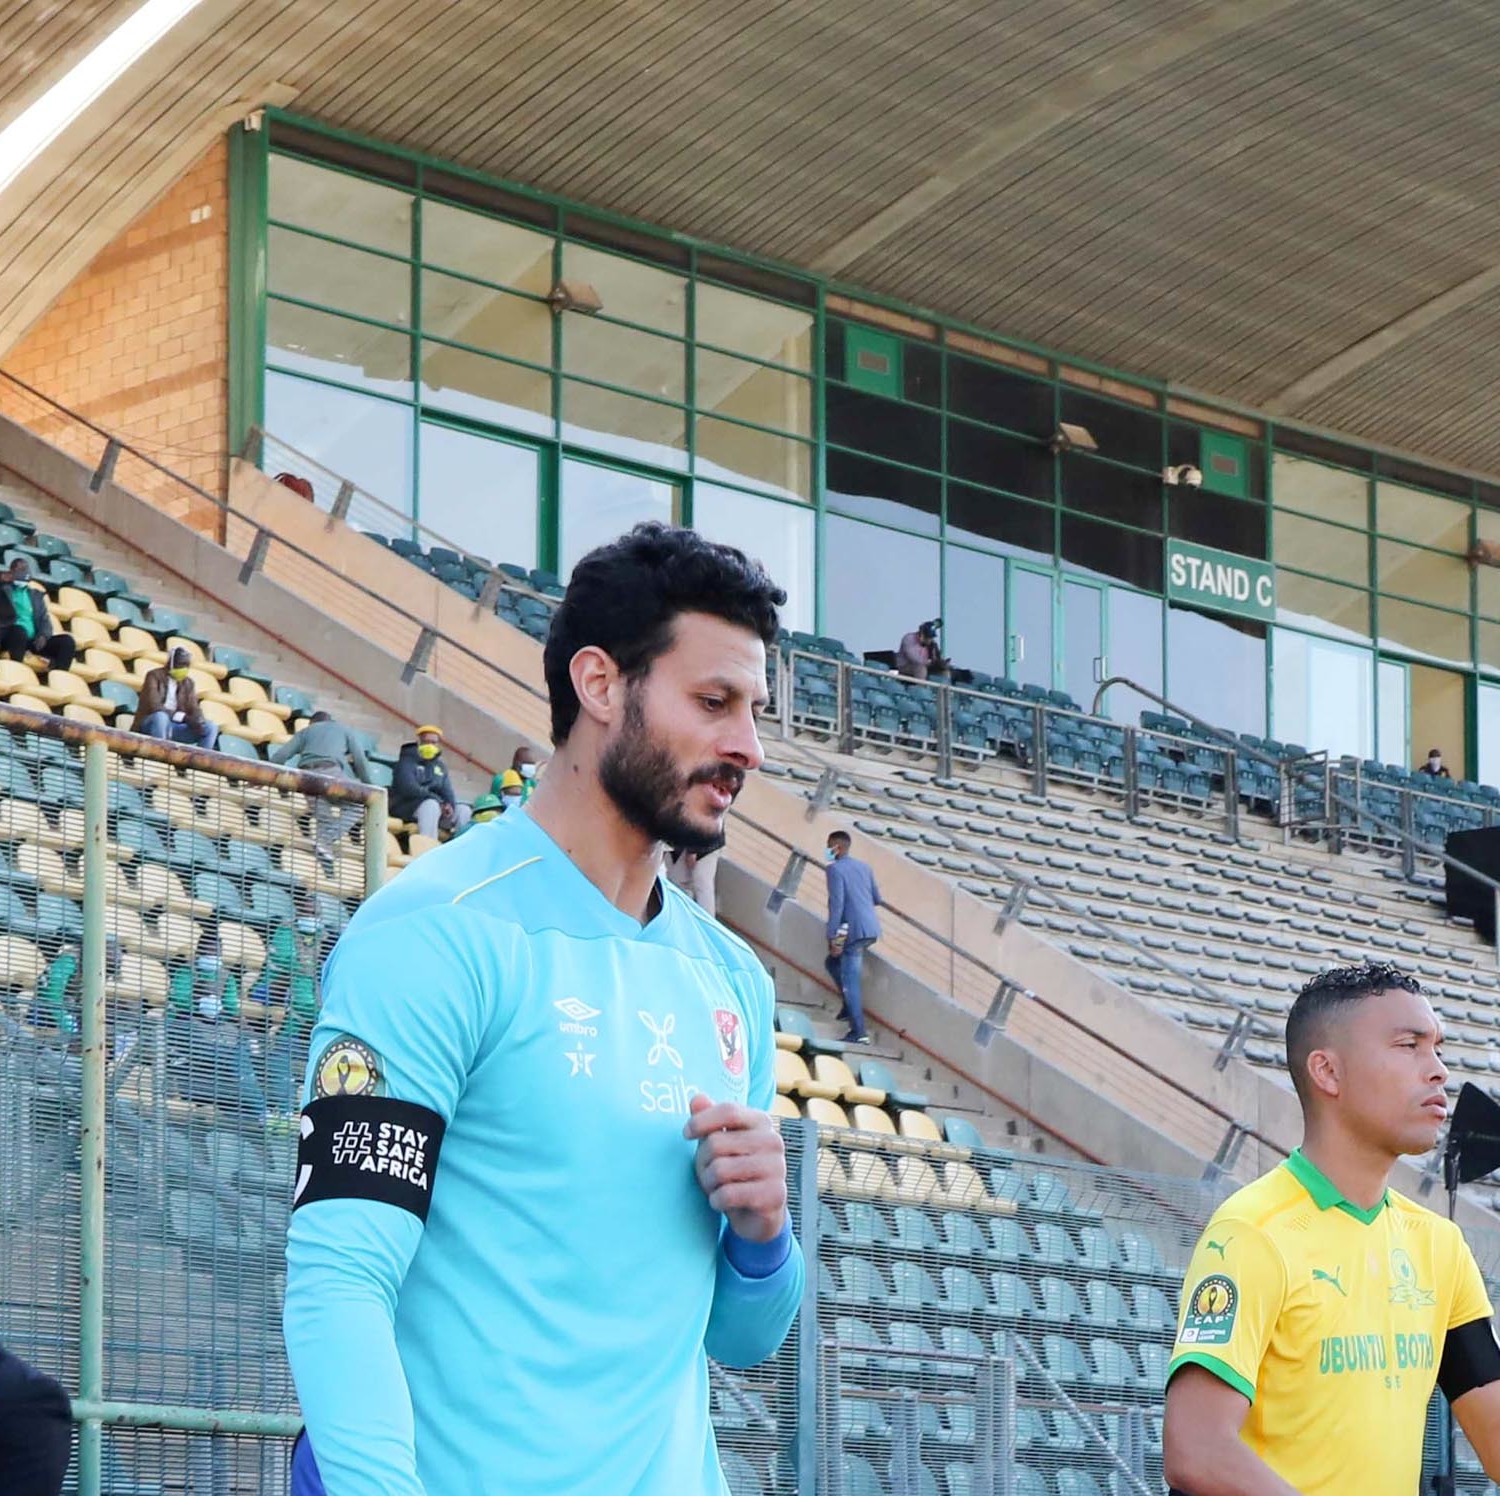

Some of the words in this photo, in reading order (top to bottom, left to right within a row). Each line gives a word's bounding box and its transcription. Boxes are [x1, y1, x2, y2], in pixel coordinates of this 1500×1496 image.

[1171, 553, 1250, 602] STAND
[1256, 575, 1273, 608] C
[559, 1021, 598, 1037] umbro
[378, 1122, 429, 1150] STAY
[376, 1140, 426, 1169] SAFE
[359, 1155, 428, 1191] AFRICA
[1194, 1315, 1224, 1325] CAF
[1319, 1334, 1387, 1375] UBUNTU
